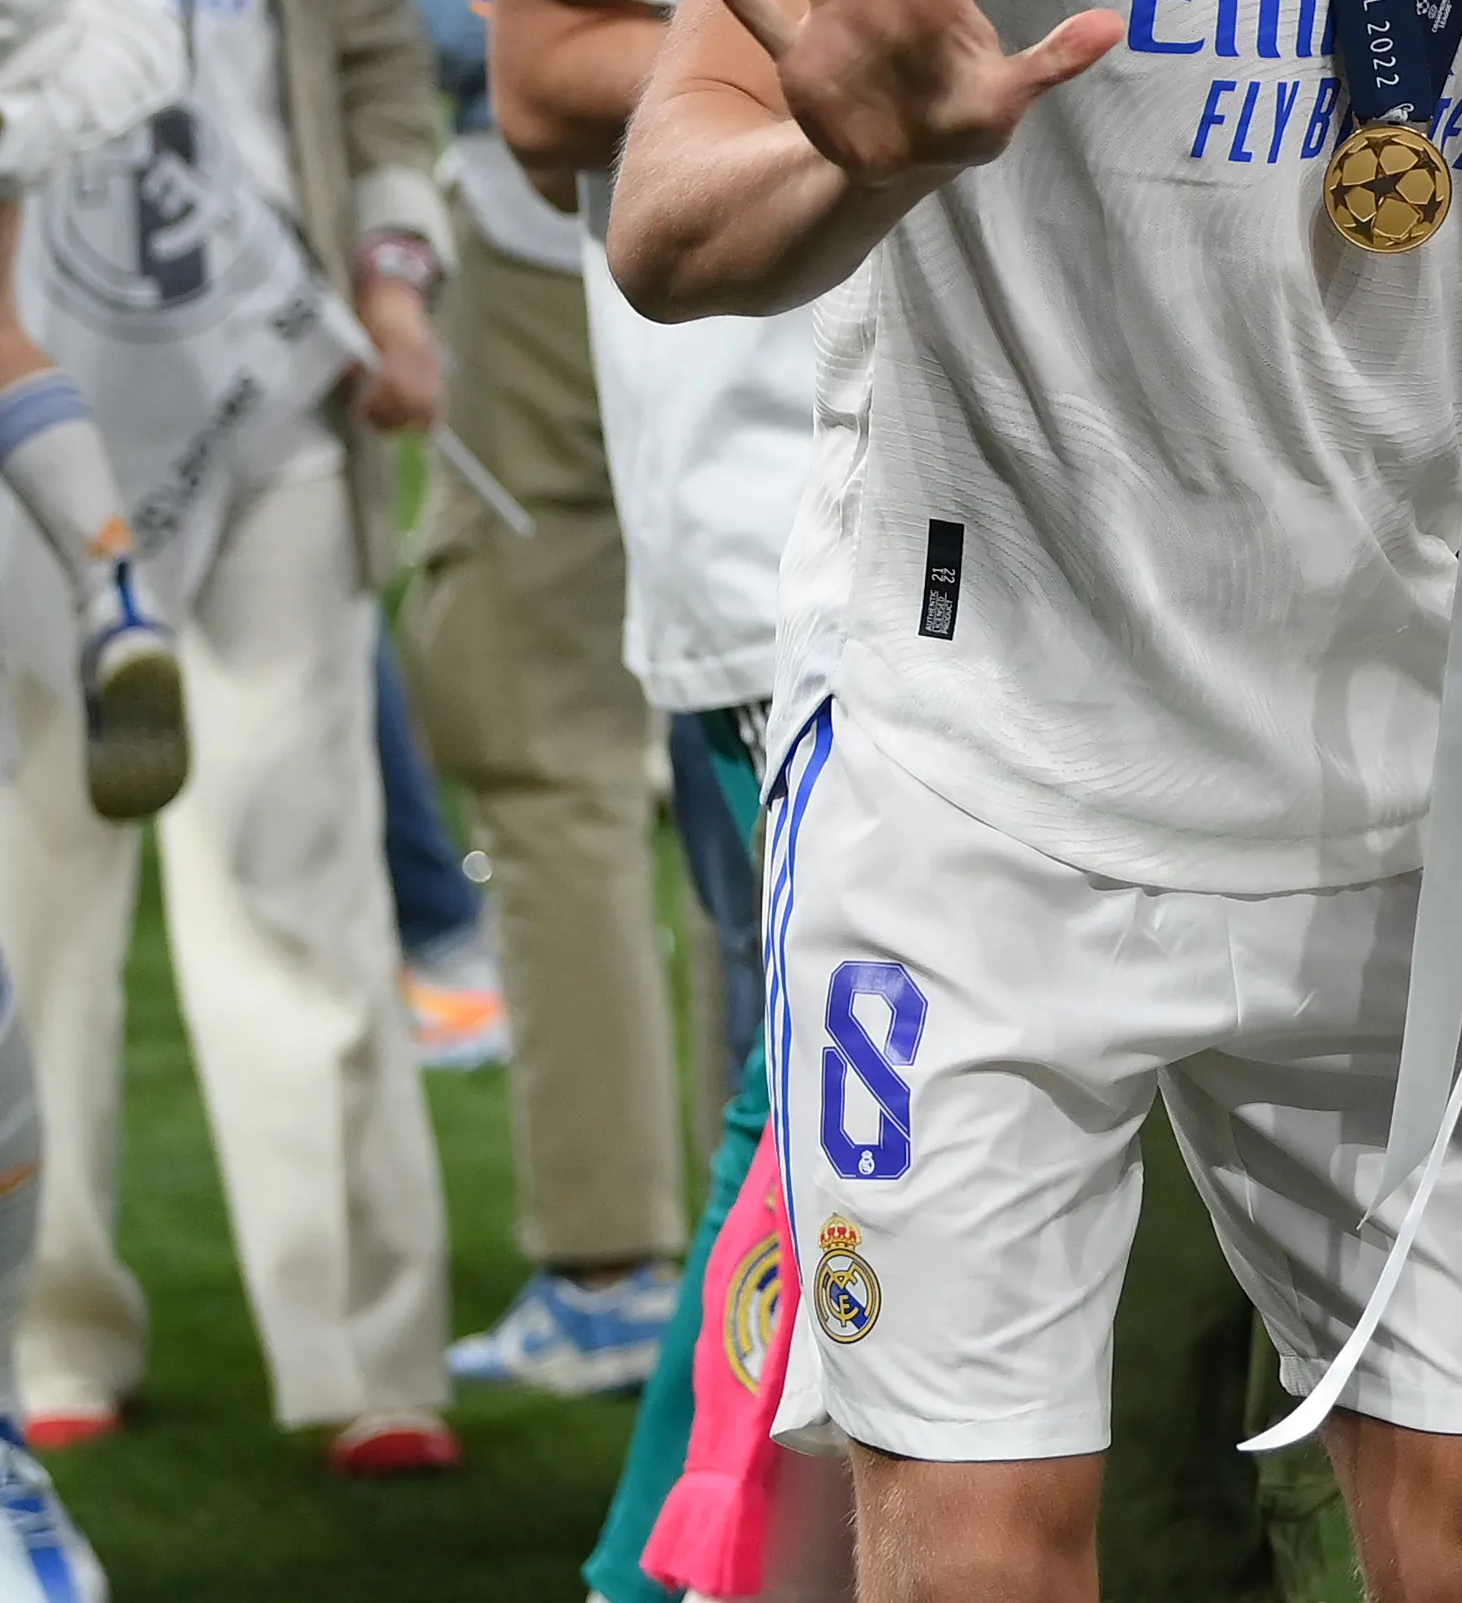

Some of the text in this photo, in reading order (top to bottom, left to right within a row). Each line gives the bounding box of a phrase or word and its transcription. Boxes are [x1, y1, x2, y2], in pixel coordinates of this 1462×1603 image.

[1367, 20, 1400, 89] 2022
[1190, 80, 1300, 164] FLY
[820, 960, 929, 1180] 8
